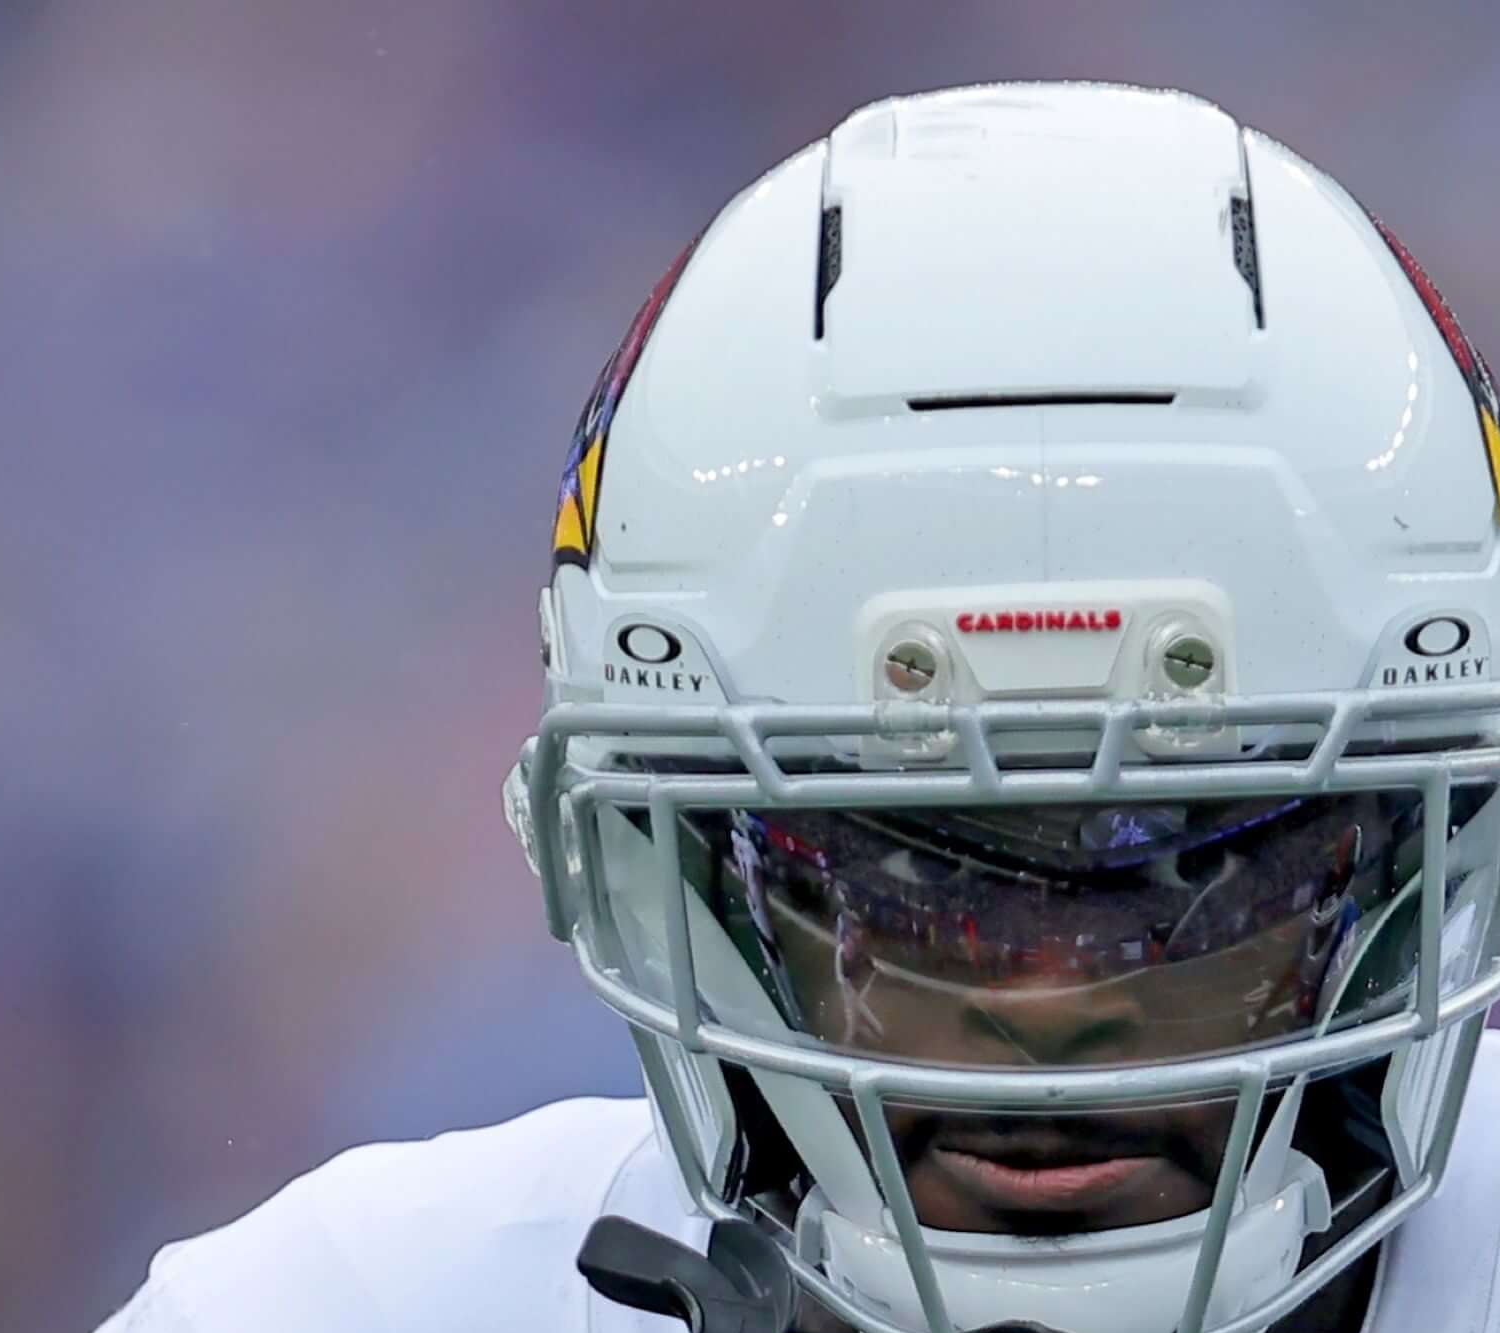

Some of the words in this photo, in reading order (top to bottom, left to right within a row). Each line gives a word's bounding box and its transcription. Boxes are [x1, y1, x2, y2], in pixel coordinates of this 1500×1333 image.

[956, 609, 1122, 633] CARDINALS
[604, 663, 703, 692] OAKLEY
[1383, 657, 1485, 685] OAKLEY
